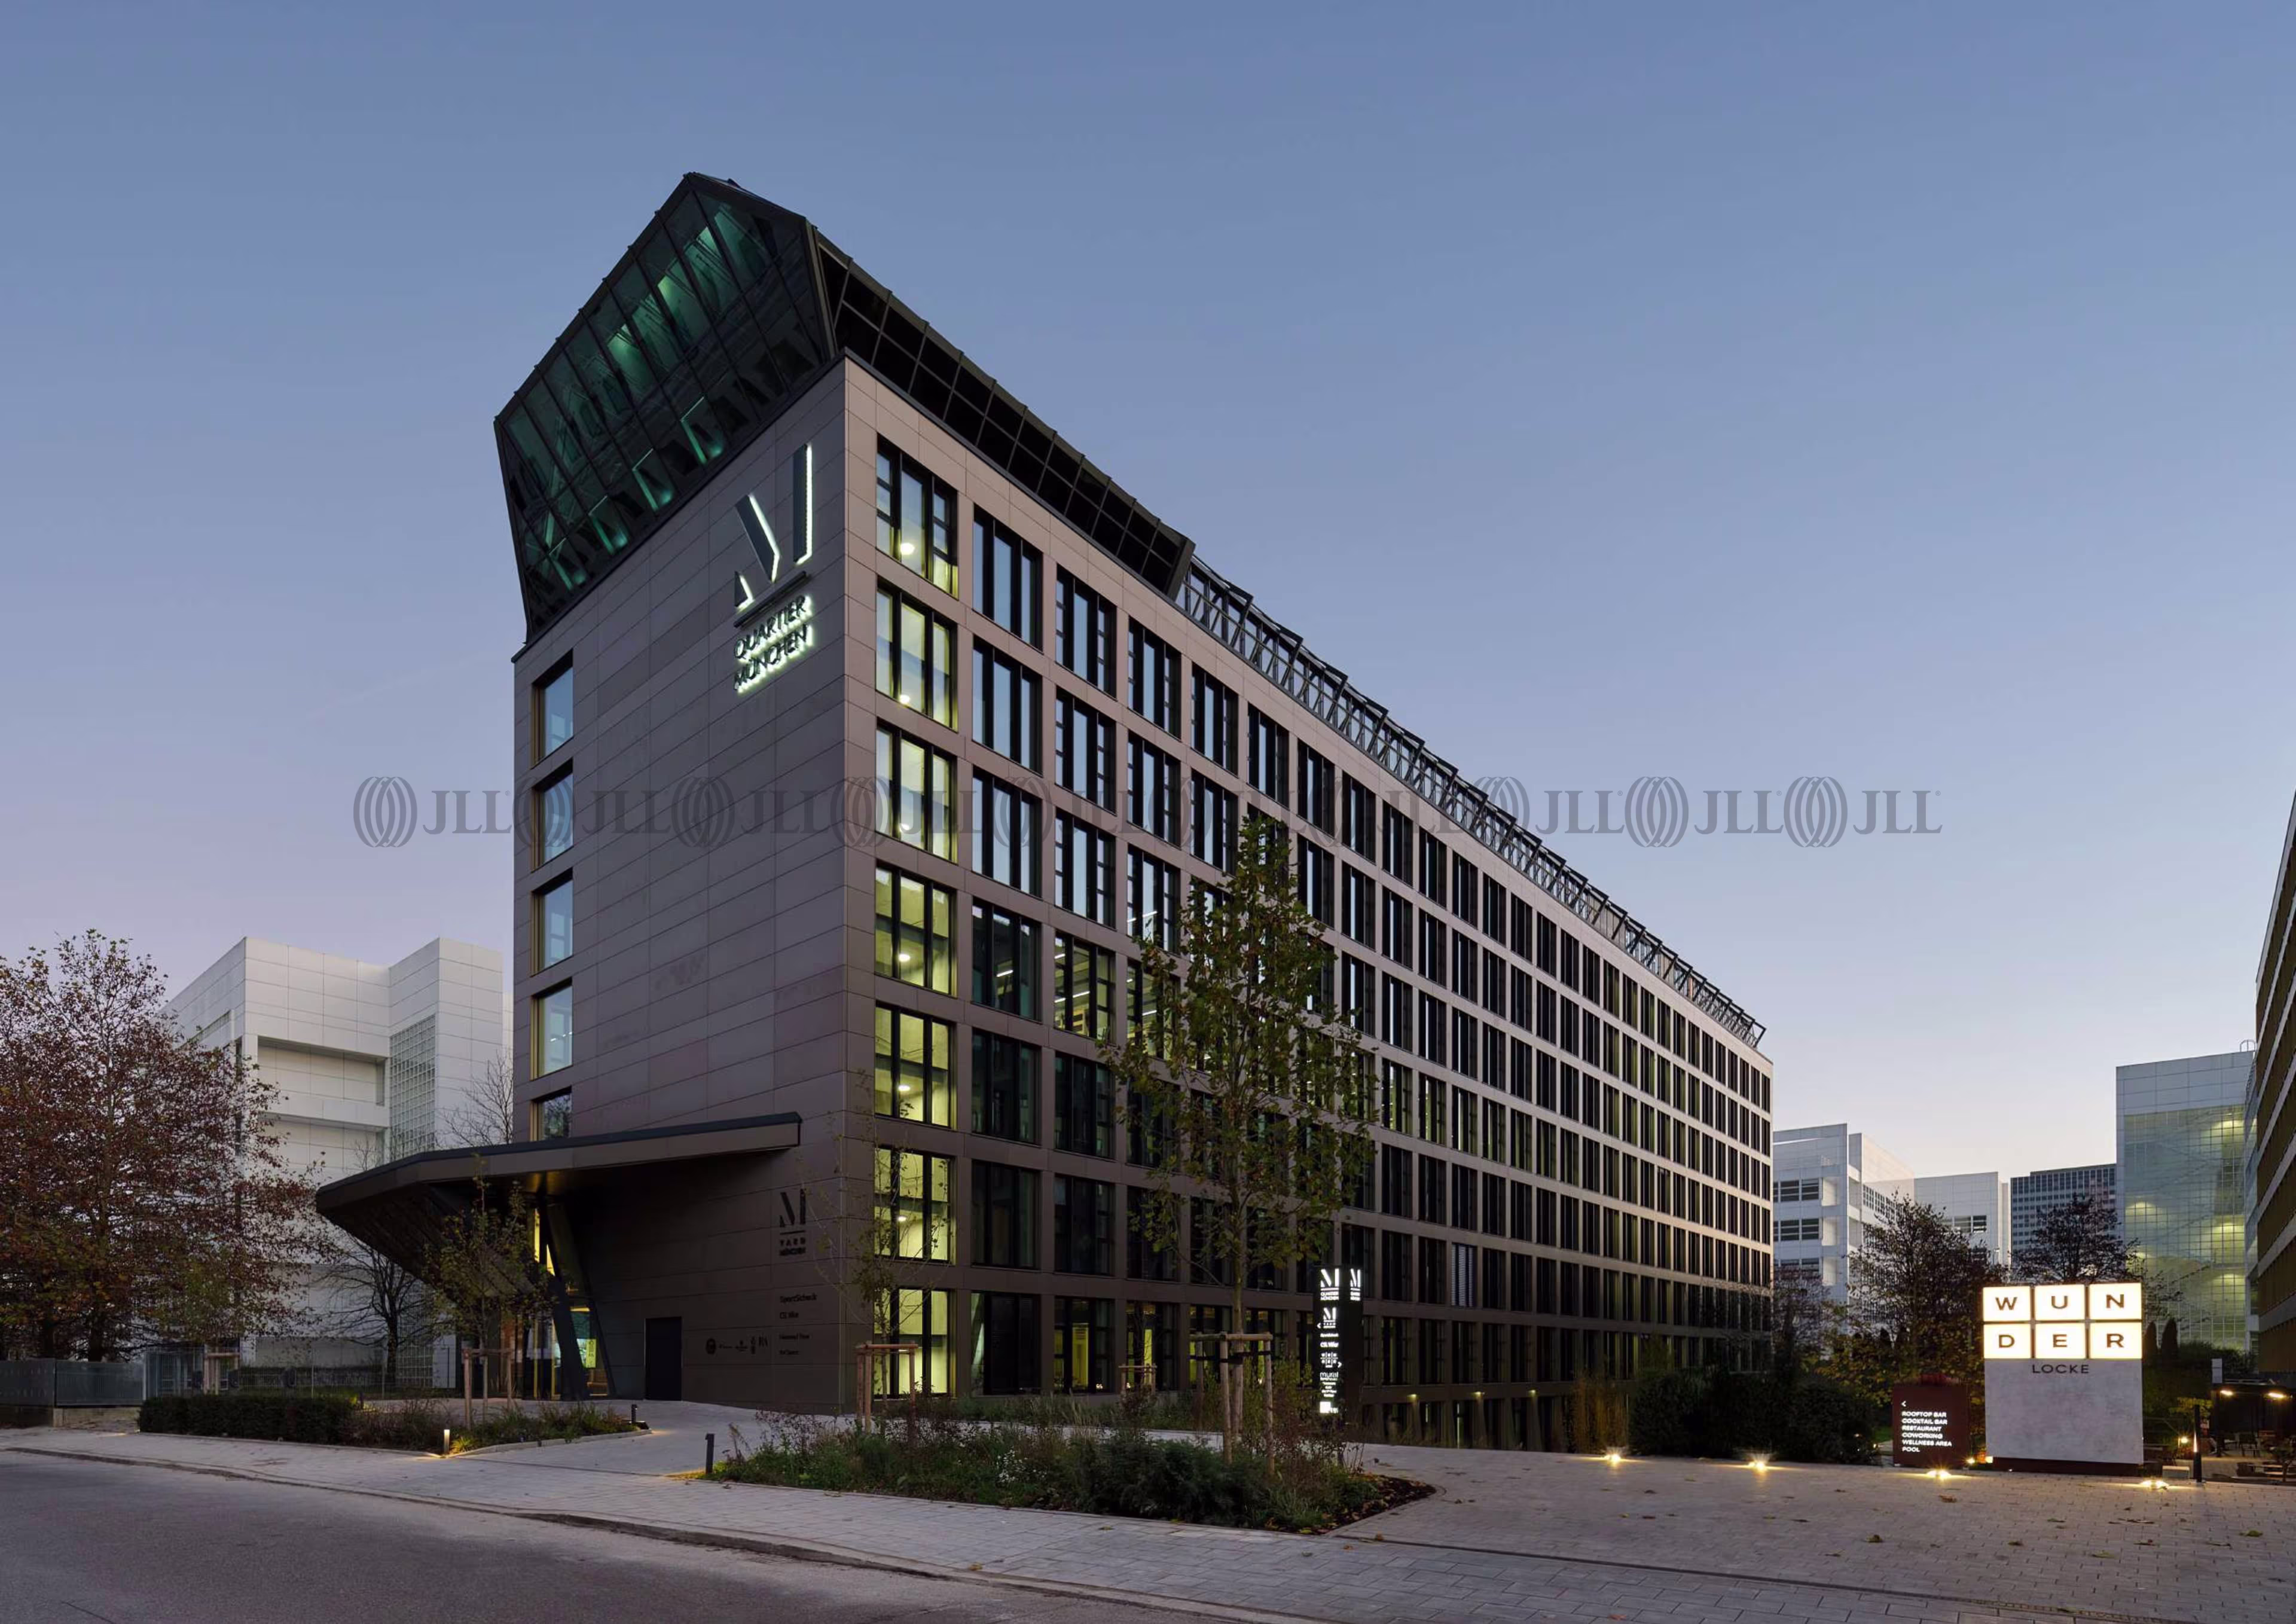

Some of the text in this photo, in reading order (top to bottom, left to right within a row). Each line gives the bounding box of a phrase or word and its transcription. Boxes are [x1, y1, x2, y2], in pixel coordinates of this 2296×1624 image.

[734, 595, 812, 660] QUARTIER
[734, 624, 814, 693] MÜNCHEN
[2032, 1364, 2089, 1373] LOCKE
